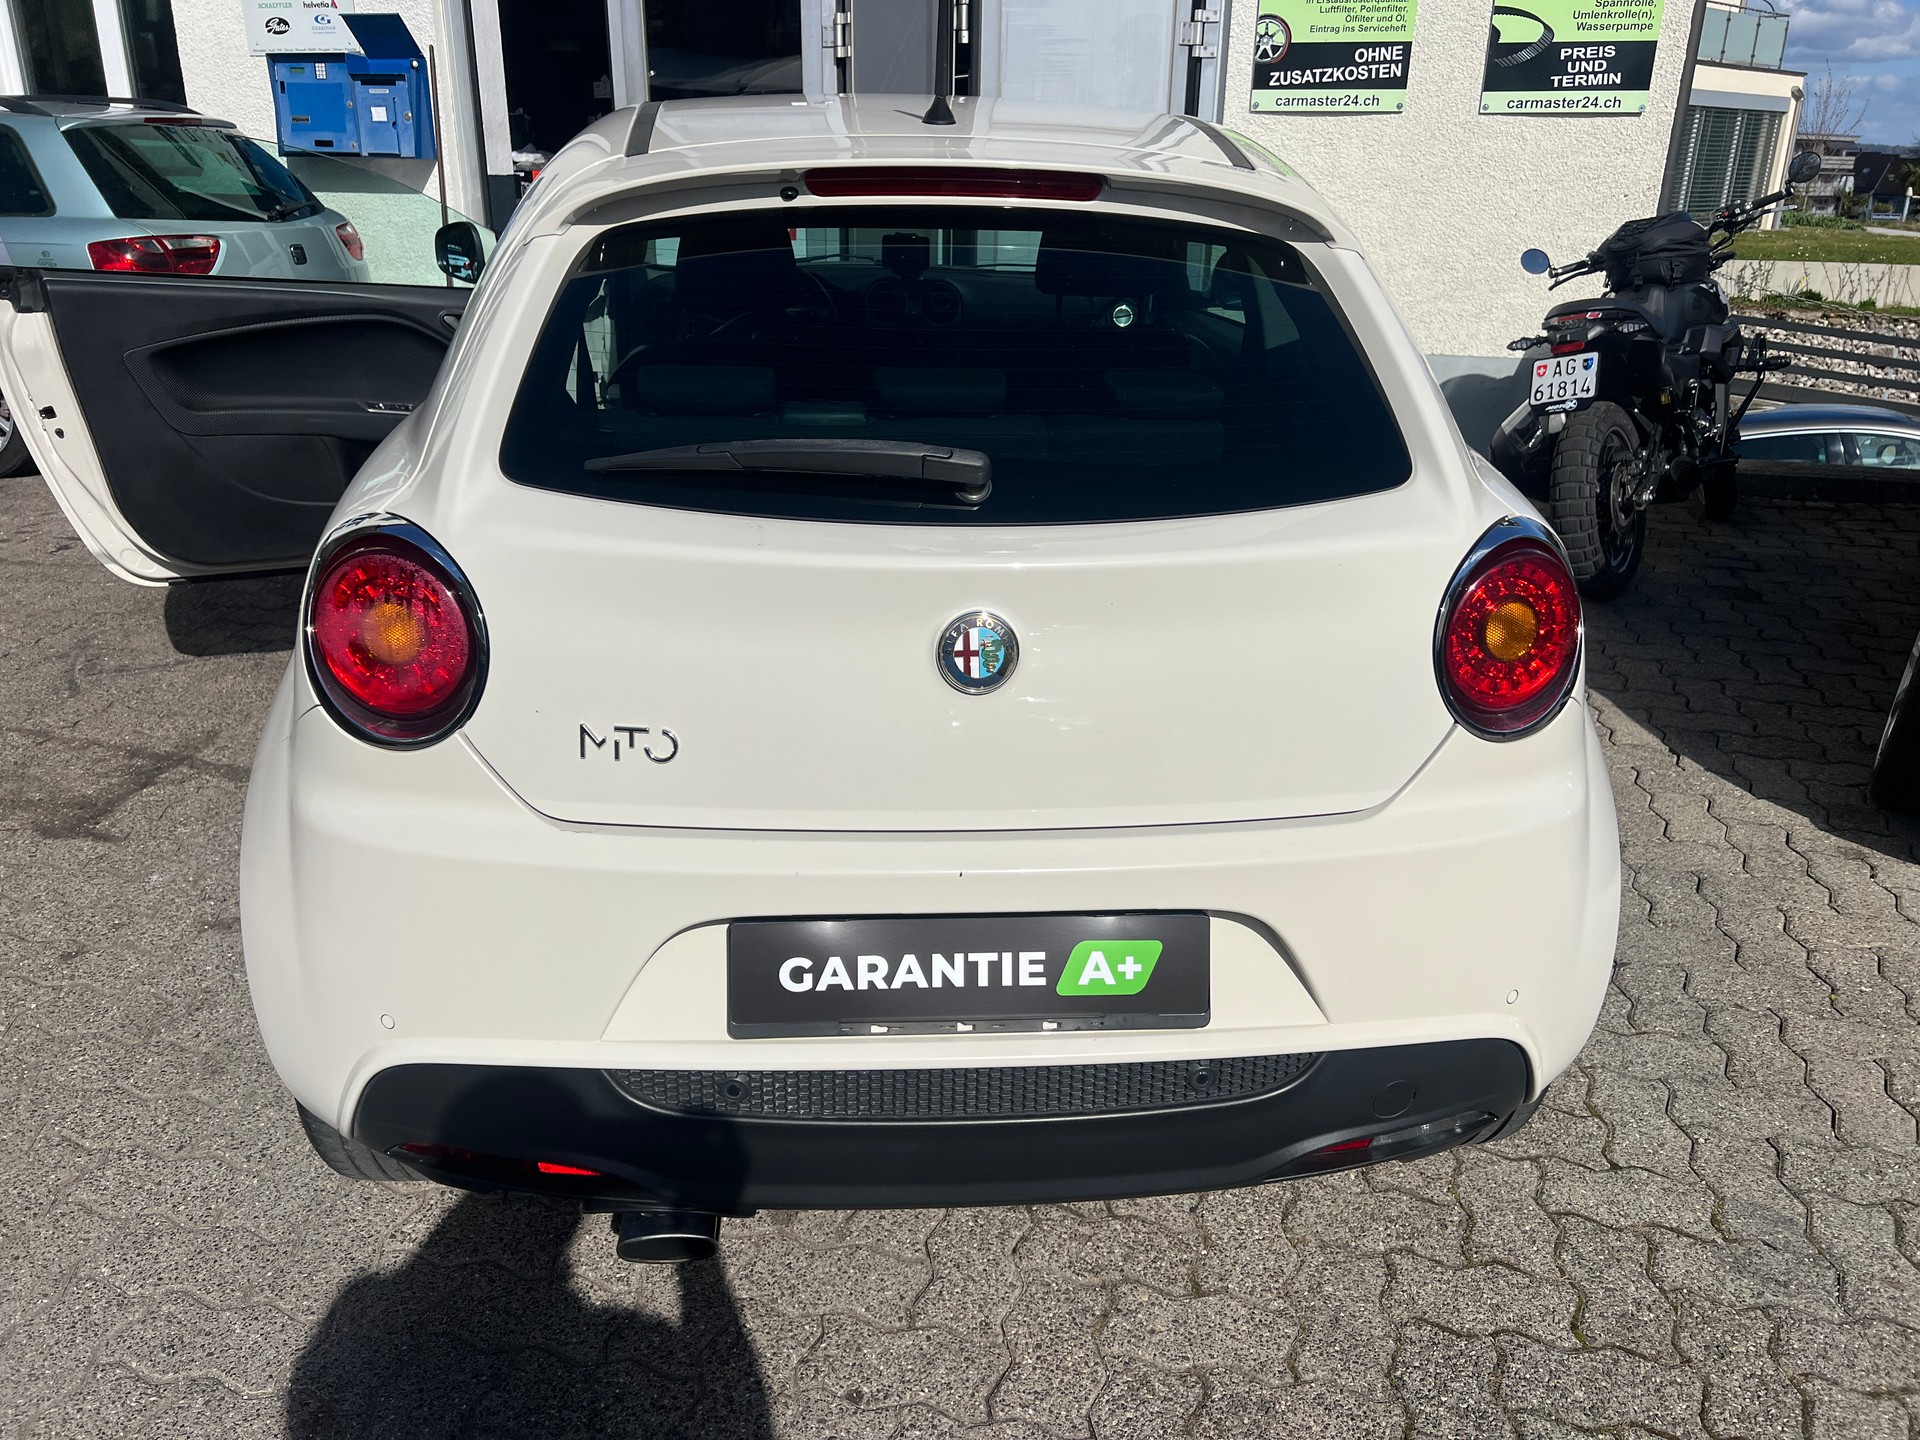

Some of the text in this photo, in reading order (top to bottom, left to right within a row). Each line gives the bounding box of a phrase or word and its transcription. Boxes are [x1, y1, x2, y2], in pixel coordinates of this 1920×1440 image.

[303, 1, 330, 9] helvetia
[1319, 5, 1409, 14] Luftfilter, Pollenfilter,
[1595, 0, 1657, 9] Spannrolle,
[1345, 12, 1408, 23] Ölfilter und Öl,
[1572, 9, 1655, 21] Umlenkrolle(n),
[1309, 24, 1407, 34] Eintrag ins Serviceheft
[1576, 22, 1654, 32] Wasserpumpe
[1354, 45, 1404, 63] OHNE
[1560, 45, 1617, 60] PREIS
[1567, 59, 1608, 74] UND
[1269, 62, 1402, 87] ZUSATZKOSTEN
[1550, 72, 1622, 88] TERMIN
[1275, 94, 1380, 107] carmaster24.ch
[1507, 96, 1622, 109] carmaster24.ch
[1553, 359, 1576, 377] AG
[1534, 377, 1591, 401] 61814
[944, 618, 1014, 656] ALFA ROMEO
[778, 950, 1143, 993] GARANTIE A+
